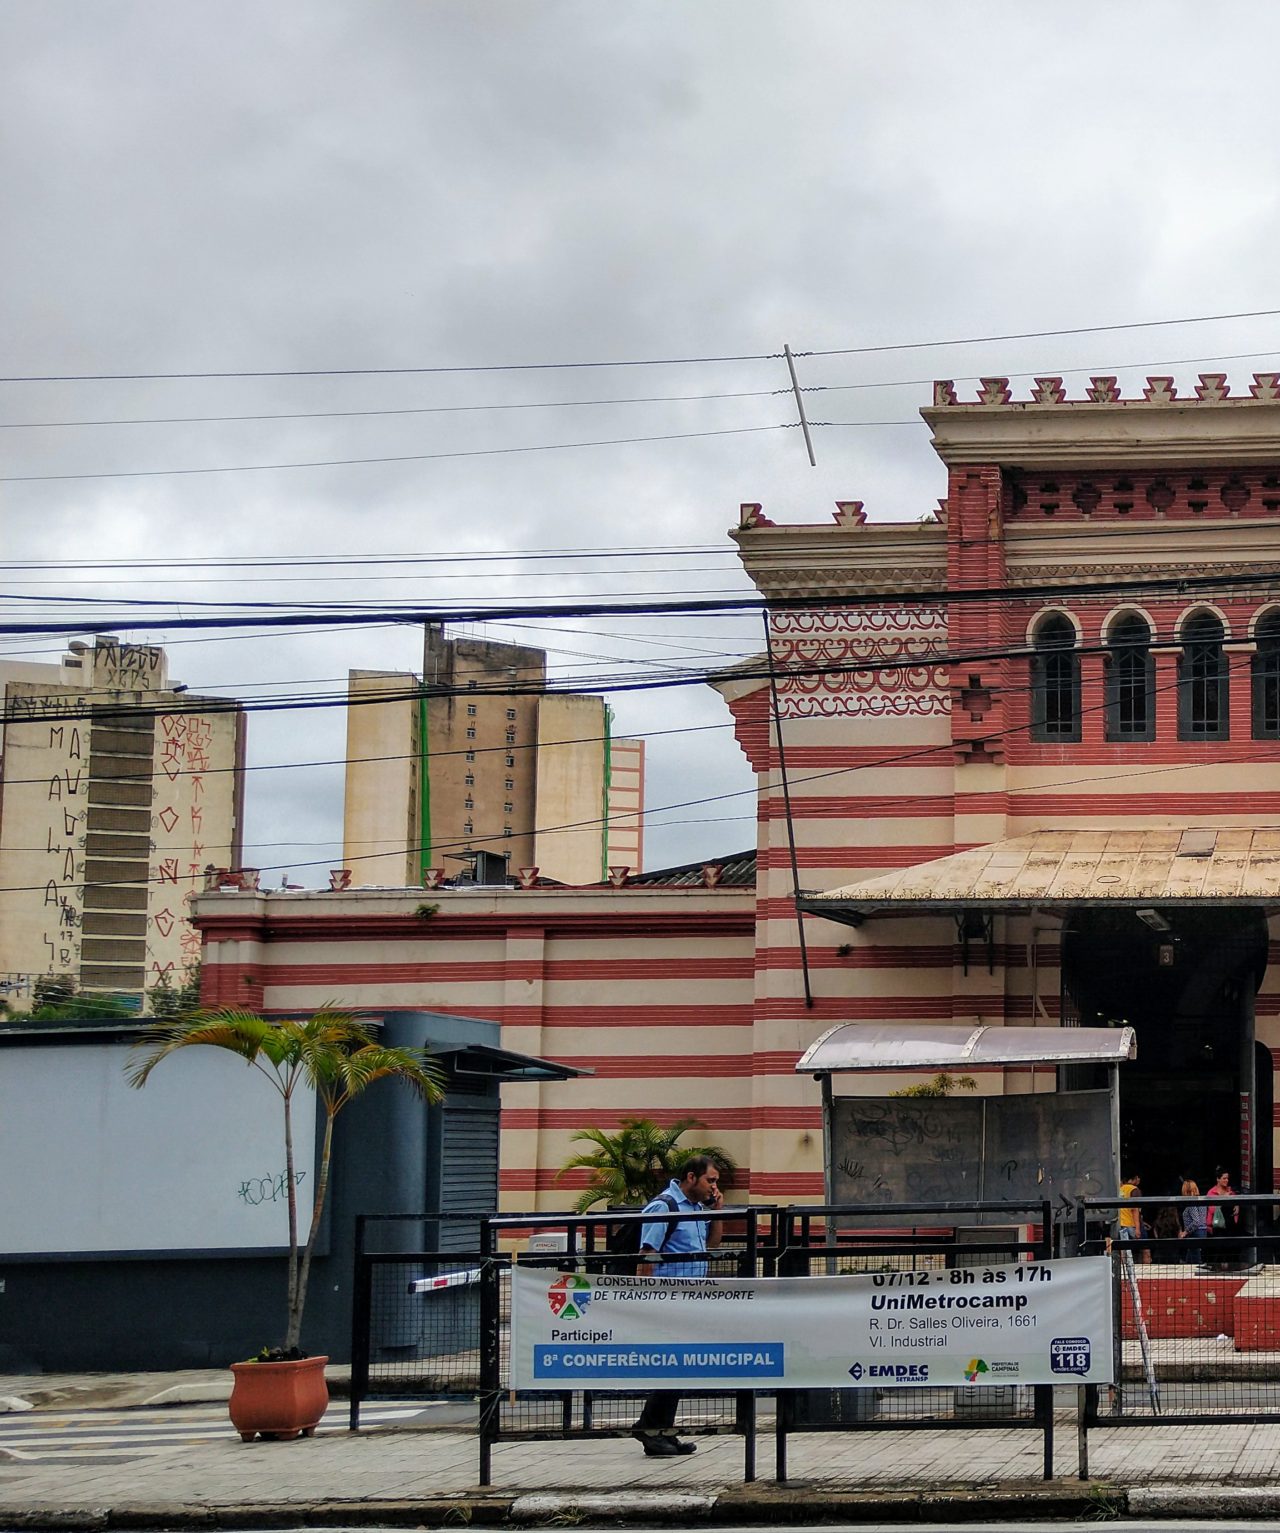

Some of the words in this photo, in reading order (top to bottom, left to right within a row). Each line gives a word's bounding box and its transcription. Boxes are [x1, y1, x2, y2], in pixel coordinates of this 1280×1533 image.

[596, 1276, 656, 1287] CONSELHO
[659, 1278, 720, 1287] MUNICIPAL
[872, 1272, 930, 1287] 07/12
[950, 1269, 975, 1285] 8h
[982, 1268, 1007, 1283] às
[1014, 1265, 1052, 1282] 17h
[594, 1290, 609, 1301] DE
[612, 1289, 668, 1301] TRÂNSITO
[670, 1290, 678, 1300] E
[682, 1290, 755, 1300] TRANSPORTE
[870, 1293, 1028, 1311] UniMetrocamp
[869, 1318, 883, 1330] R.
[887, 1317, 905, 1330] Dr.
[909, 1316, 948, 1329] Salles
[951, 1315, 1003, 1329] Oliveira,
[1007, 1314, 1037, 1327] 1661
[551, 1329, 613, 1344] Participe!
[891, 1334, 948, 1348] Industrial
[562, 1352, 678, 1367] CONFERÊNCIA
[683, 1353, 775, 1366] MUNICIPAL
[1056, 1353, 1087, 1367] 118
[868, 1364, 929, 1377] EMDEC
